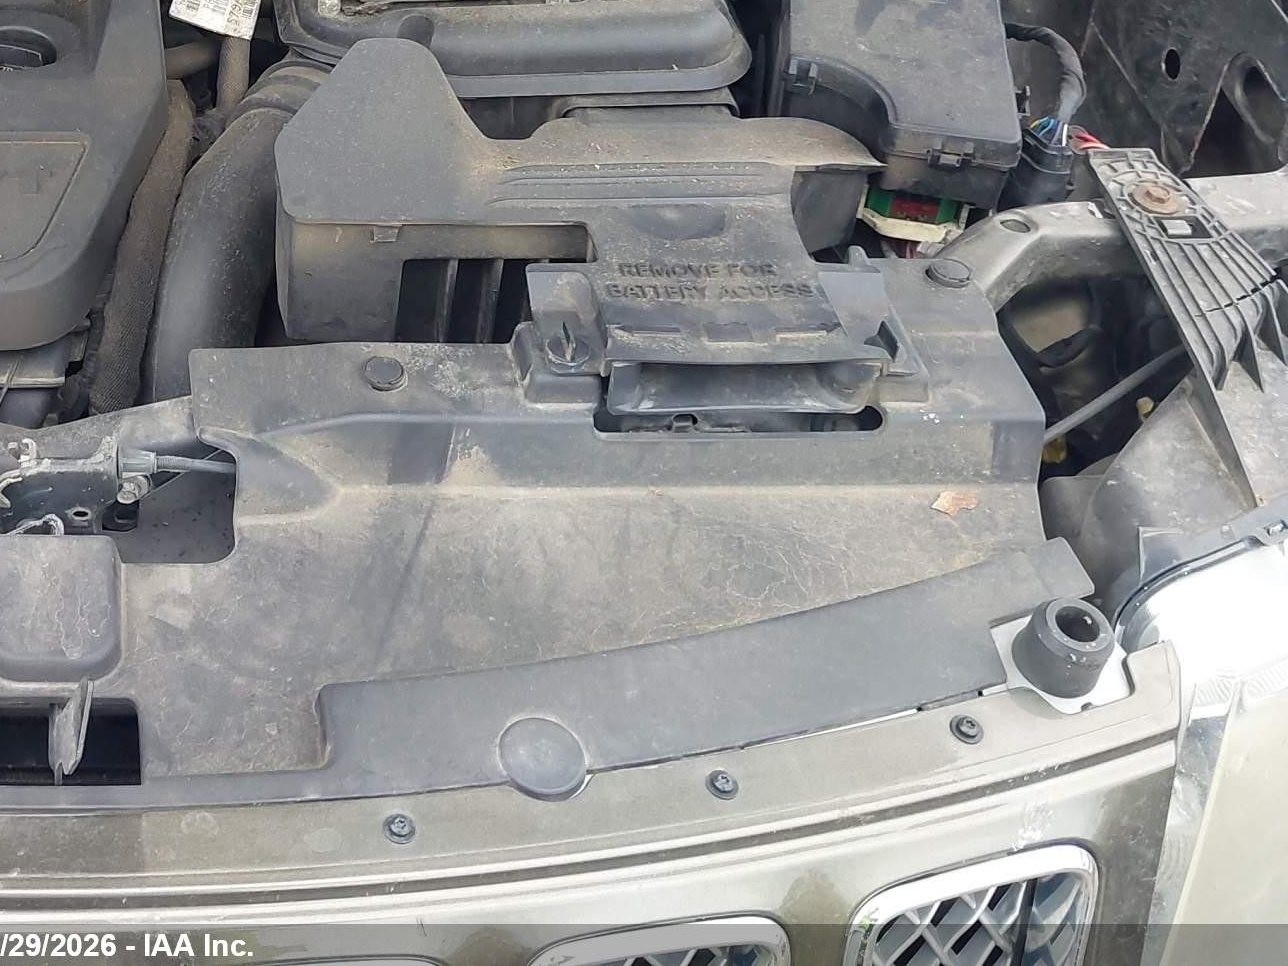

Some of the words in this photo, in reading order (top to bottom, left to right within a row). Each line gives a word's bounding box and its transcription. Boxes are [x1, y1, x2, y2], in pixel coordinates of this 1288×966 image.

[618, 262, 721, 279] REMOVE
[727, 262, 778, 278] FOR
[607, 282, 708, 300] BATTERY
[718, 282, 816, 299] ACCESS
